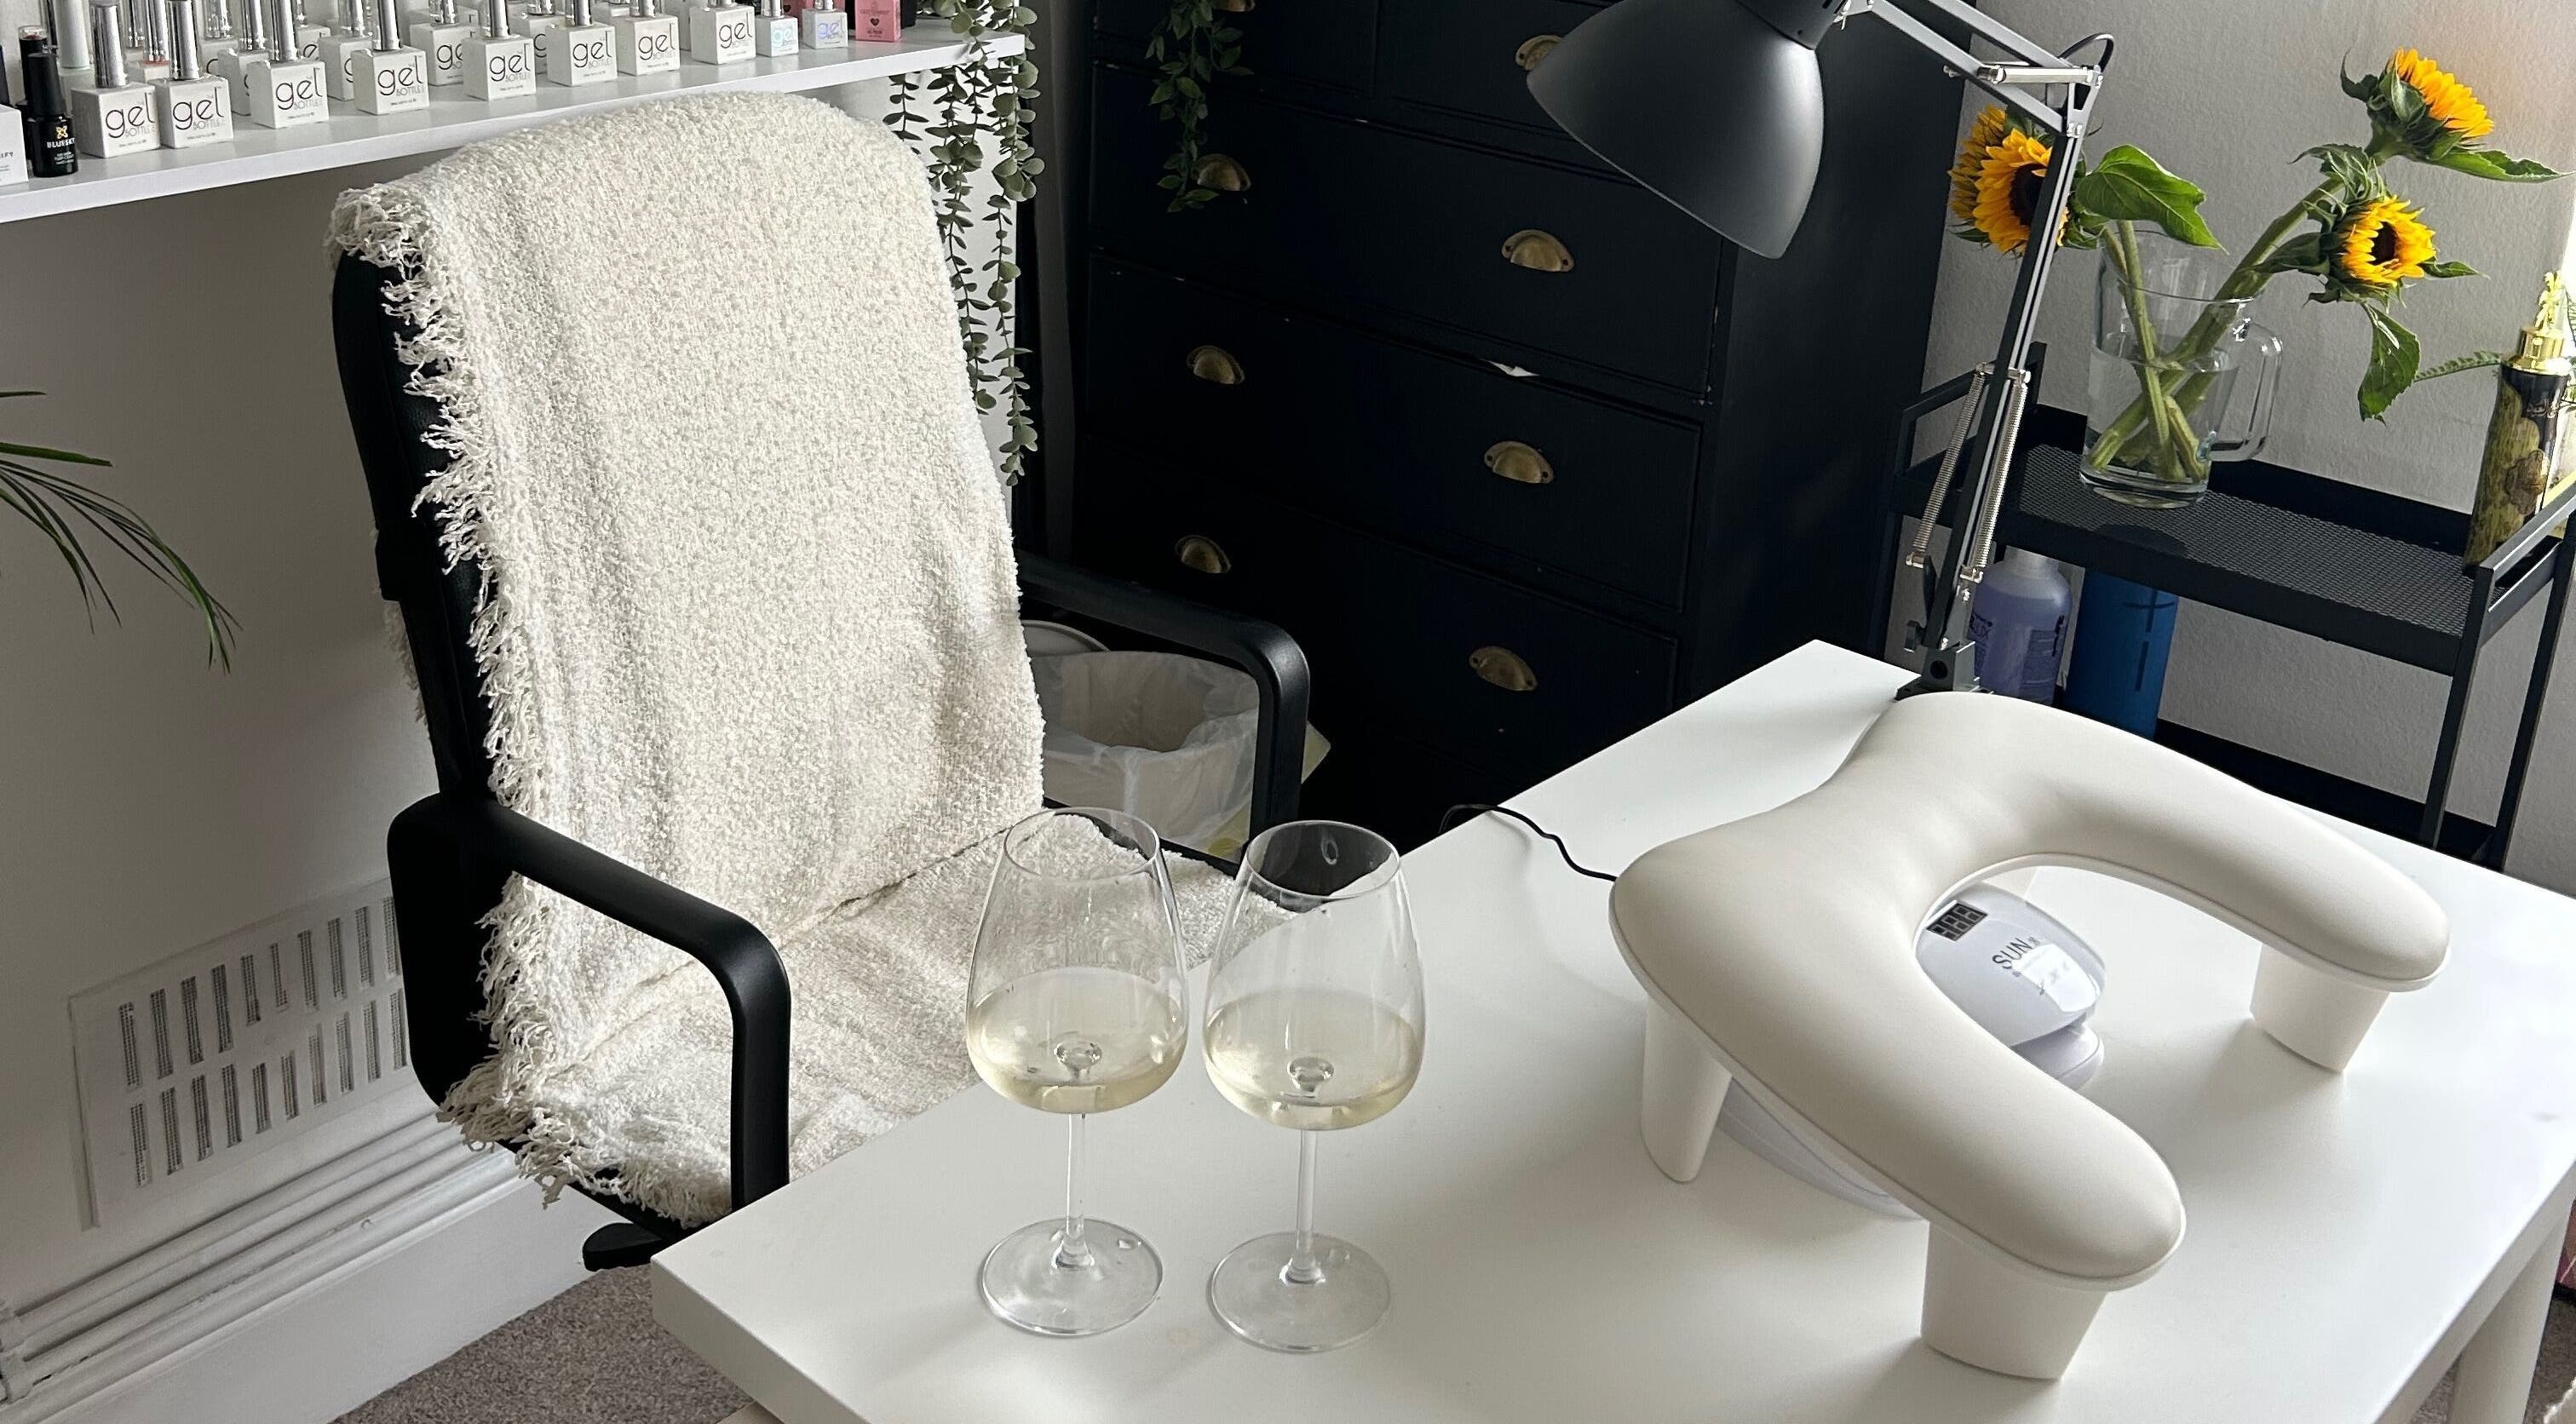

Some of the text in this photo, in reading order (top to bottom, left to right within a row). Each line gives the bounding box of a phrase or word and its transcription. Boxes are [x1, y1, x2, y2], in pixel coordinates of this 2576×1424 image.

[572, 31, 612, 68] gel
[639, 23, 676, 60] gel
[719, 12, 753, 49] gel
[378, 55, 423, 96] gel
[489, 43, 531, 82] gel
[172, 86, 224, 130] gel
[275, 67, 323, 110] gel
[105, 92, 155, 139] gel
[1992, 937, 2032, 970] SUN
